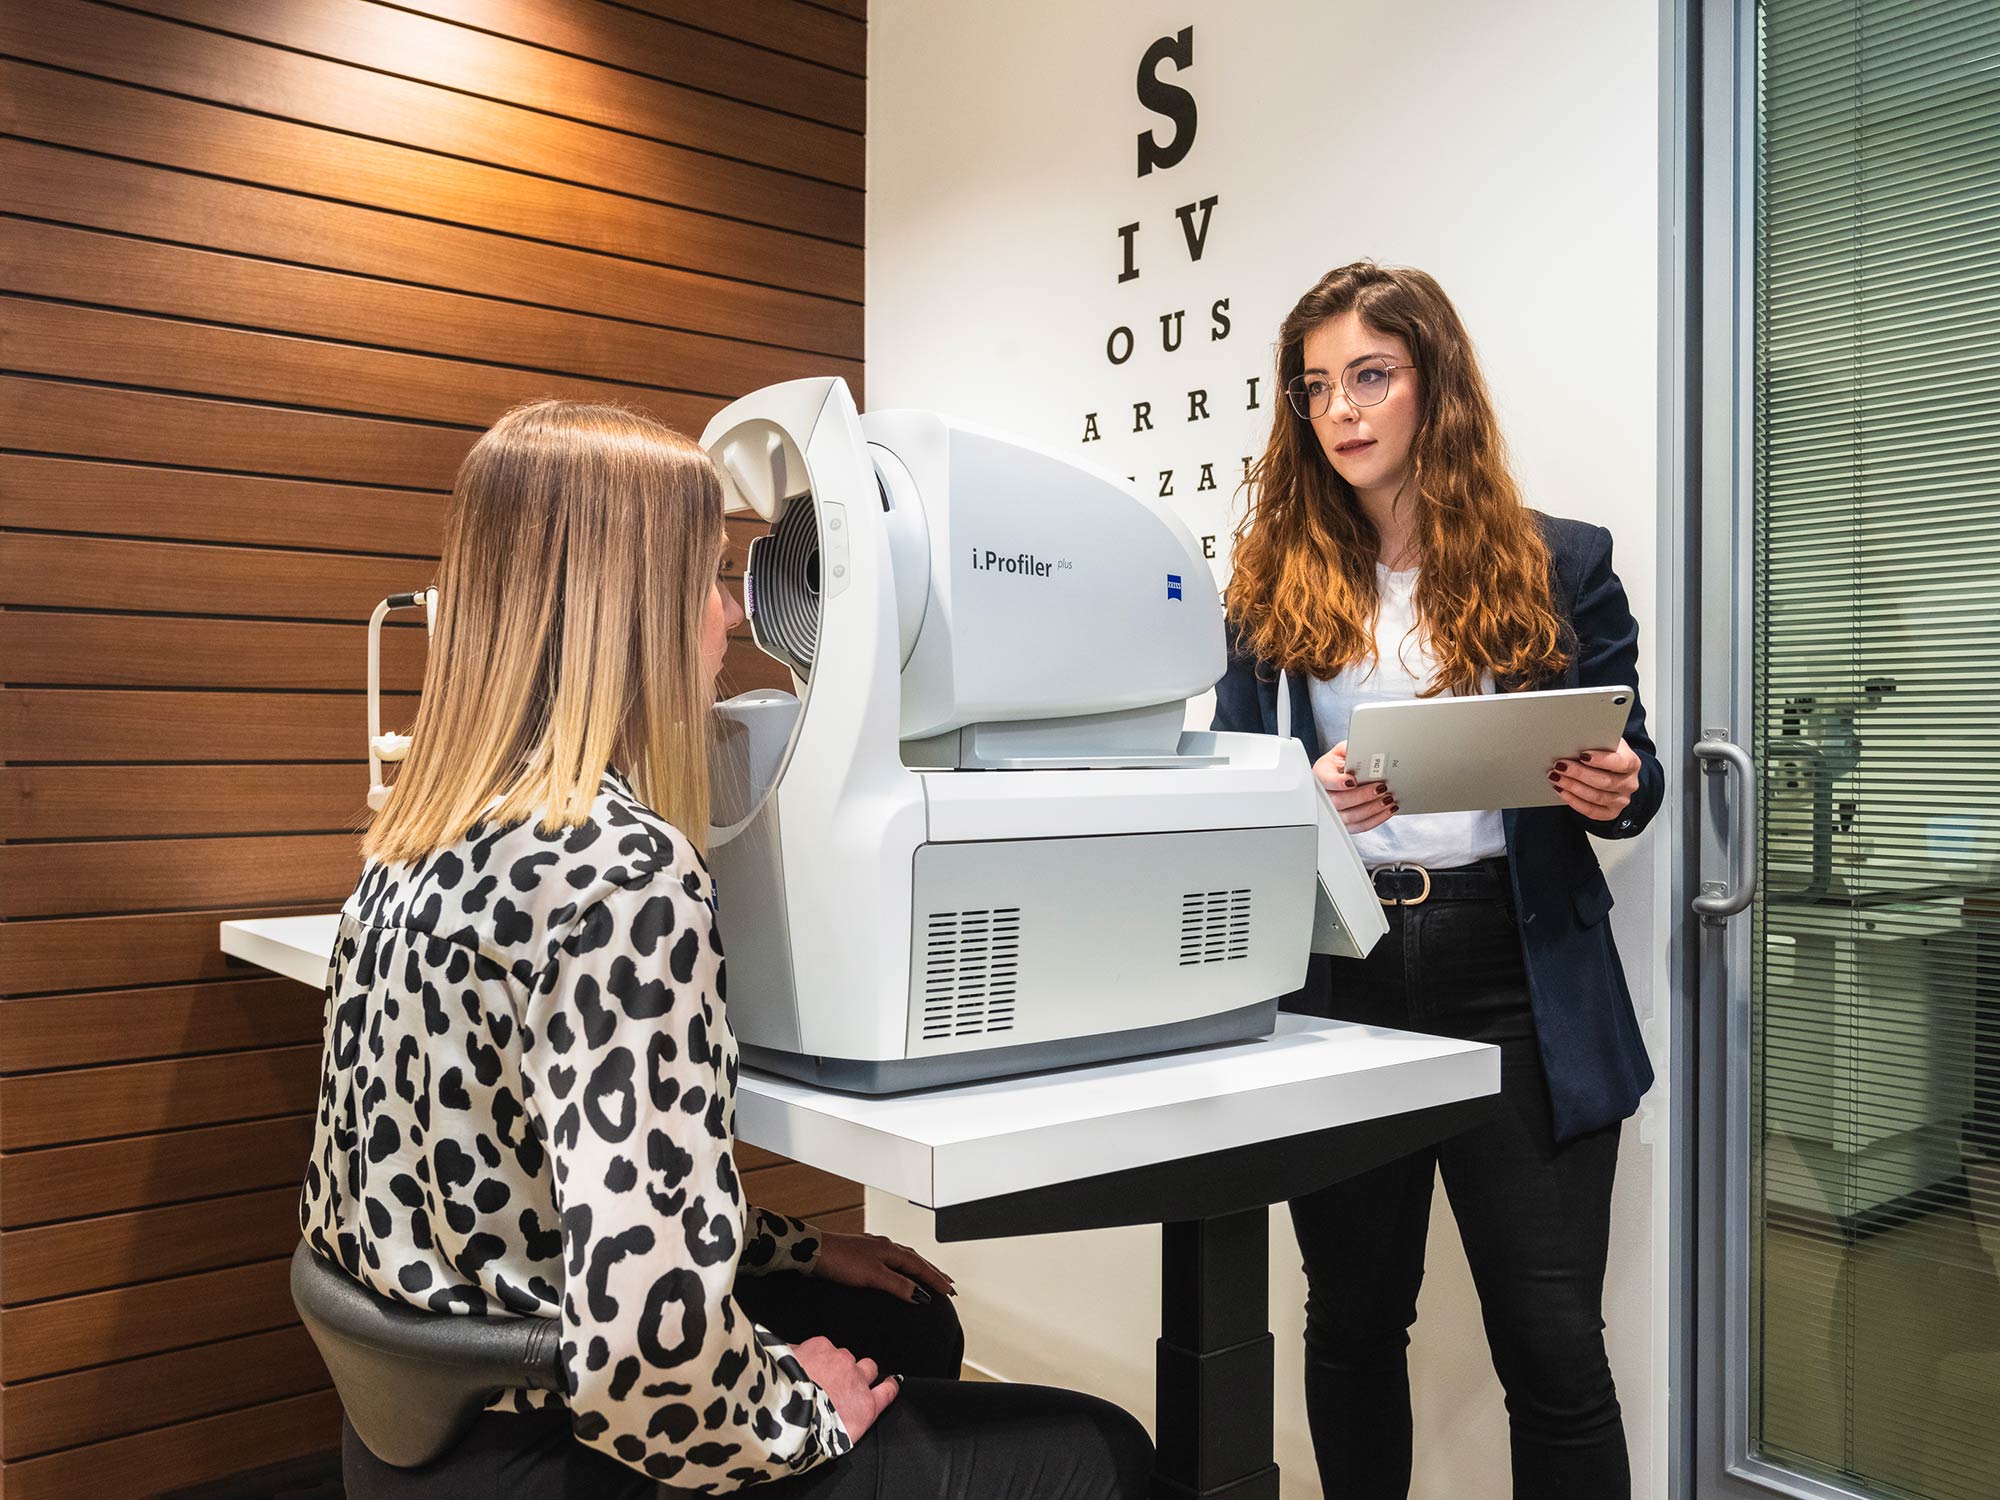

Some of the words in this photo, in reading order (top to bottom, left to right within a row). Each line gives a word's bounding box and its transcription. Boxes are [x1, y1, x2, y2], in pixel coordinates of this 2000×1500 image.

[1136, 25, 1198, 178] S
[1175, 194, 1219, 262] V
[973, 547, 1052, 578] i.Profiler
[1057, 557, 1073, 571] plus
[1201, 535, 1216, 559] E
